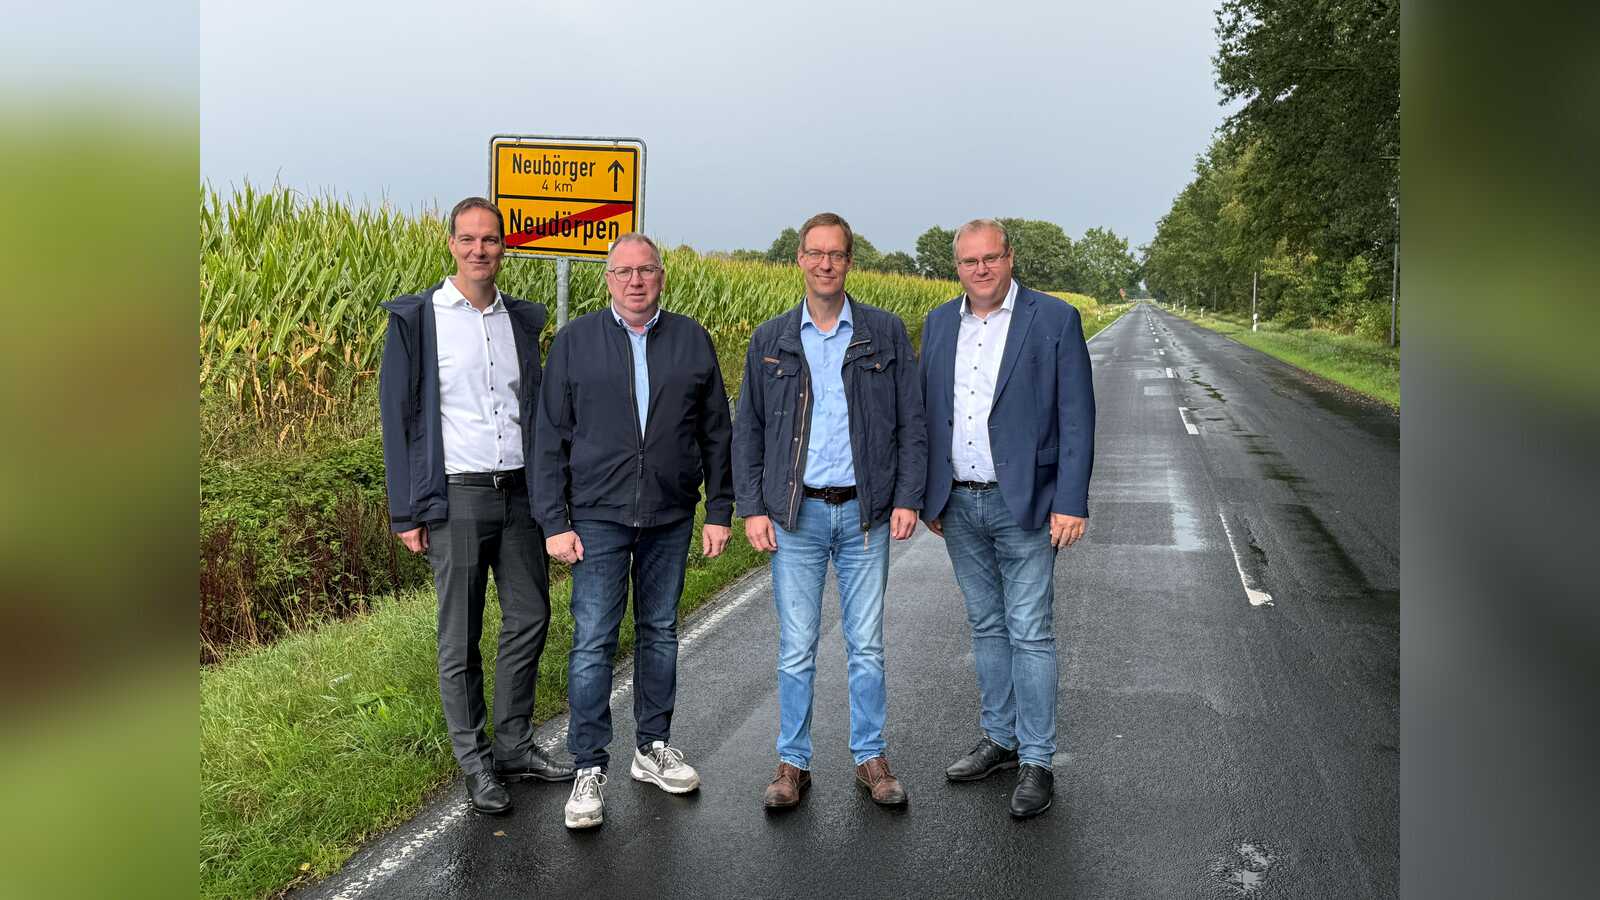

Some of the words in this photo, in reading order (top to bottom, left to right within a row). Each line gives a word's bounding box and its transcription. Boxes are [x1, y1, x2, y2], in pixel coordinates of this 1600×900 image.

[512, 153, 596, 182] Neubörger
[541, 179, 549, 192] 4
[554, 180, 573, 193] km
[509, 208, 620, 246] Neudörpen
